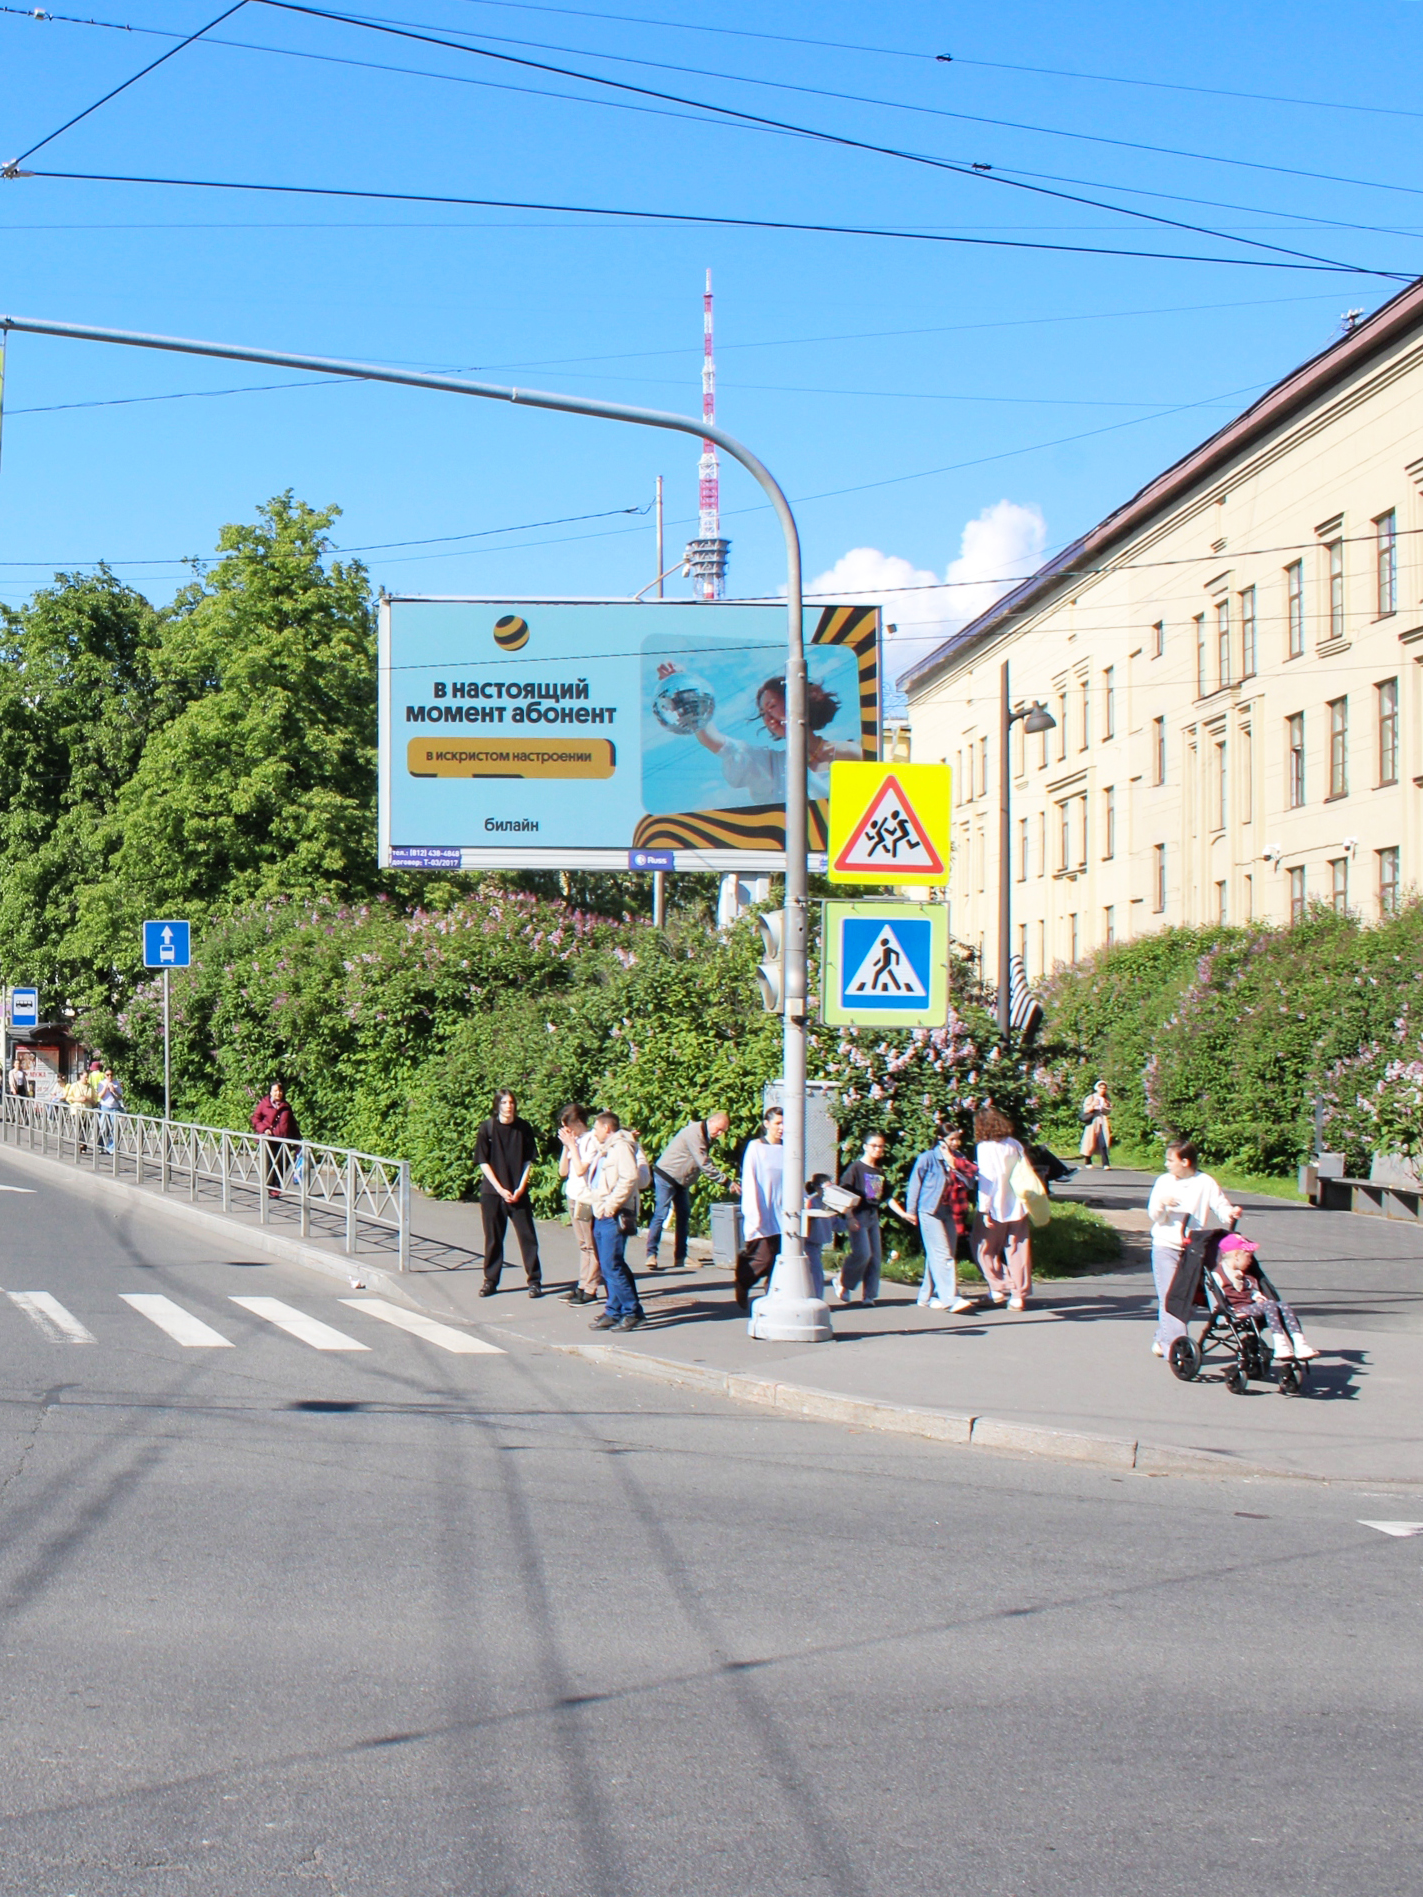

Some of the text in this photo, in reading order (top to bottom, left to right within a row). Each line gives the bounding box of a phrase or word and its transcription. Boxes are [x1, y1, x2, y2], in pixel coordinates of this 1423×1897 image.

[433, 678, 589, 703] в настоящий
[406, 702, 617, 724] момент абонент
[426, 751, 592, 764] в искристом настроении
[484, 817, 539, 832] билайн
[647, 856, 668, 865] Russ
